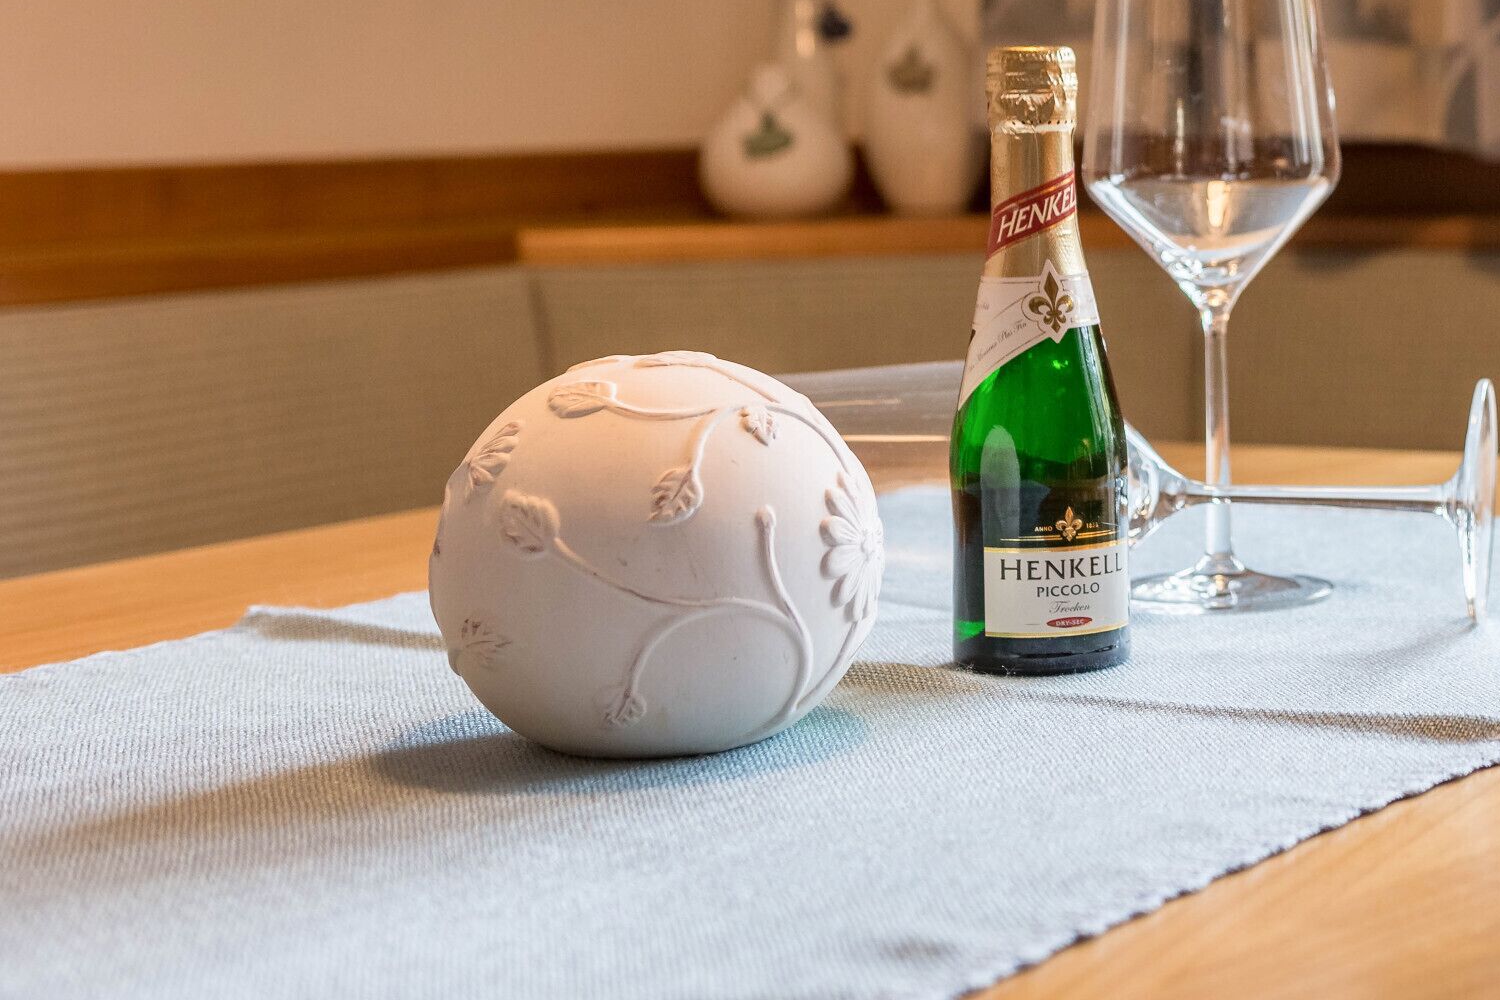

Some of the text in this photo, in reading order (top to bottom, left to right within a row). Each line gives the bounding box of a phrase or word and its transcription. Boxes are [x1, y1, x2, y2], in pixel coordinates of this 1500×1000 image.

[1000, 552, 1123, 581] HENKELL
[1036, 582, 1100, 598] PICCOLO
[1049, 600, 1091, 614] Trocken
[1055, 618, 1085, 627] DRY-SEC
